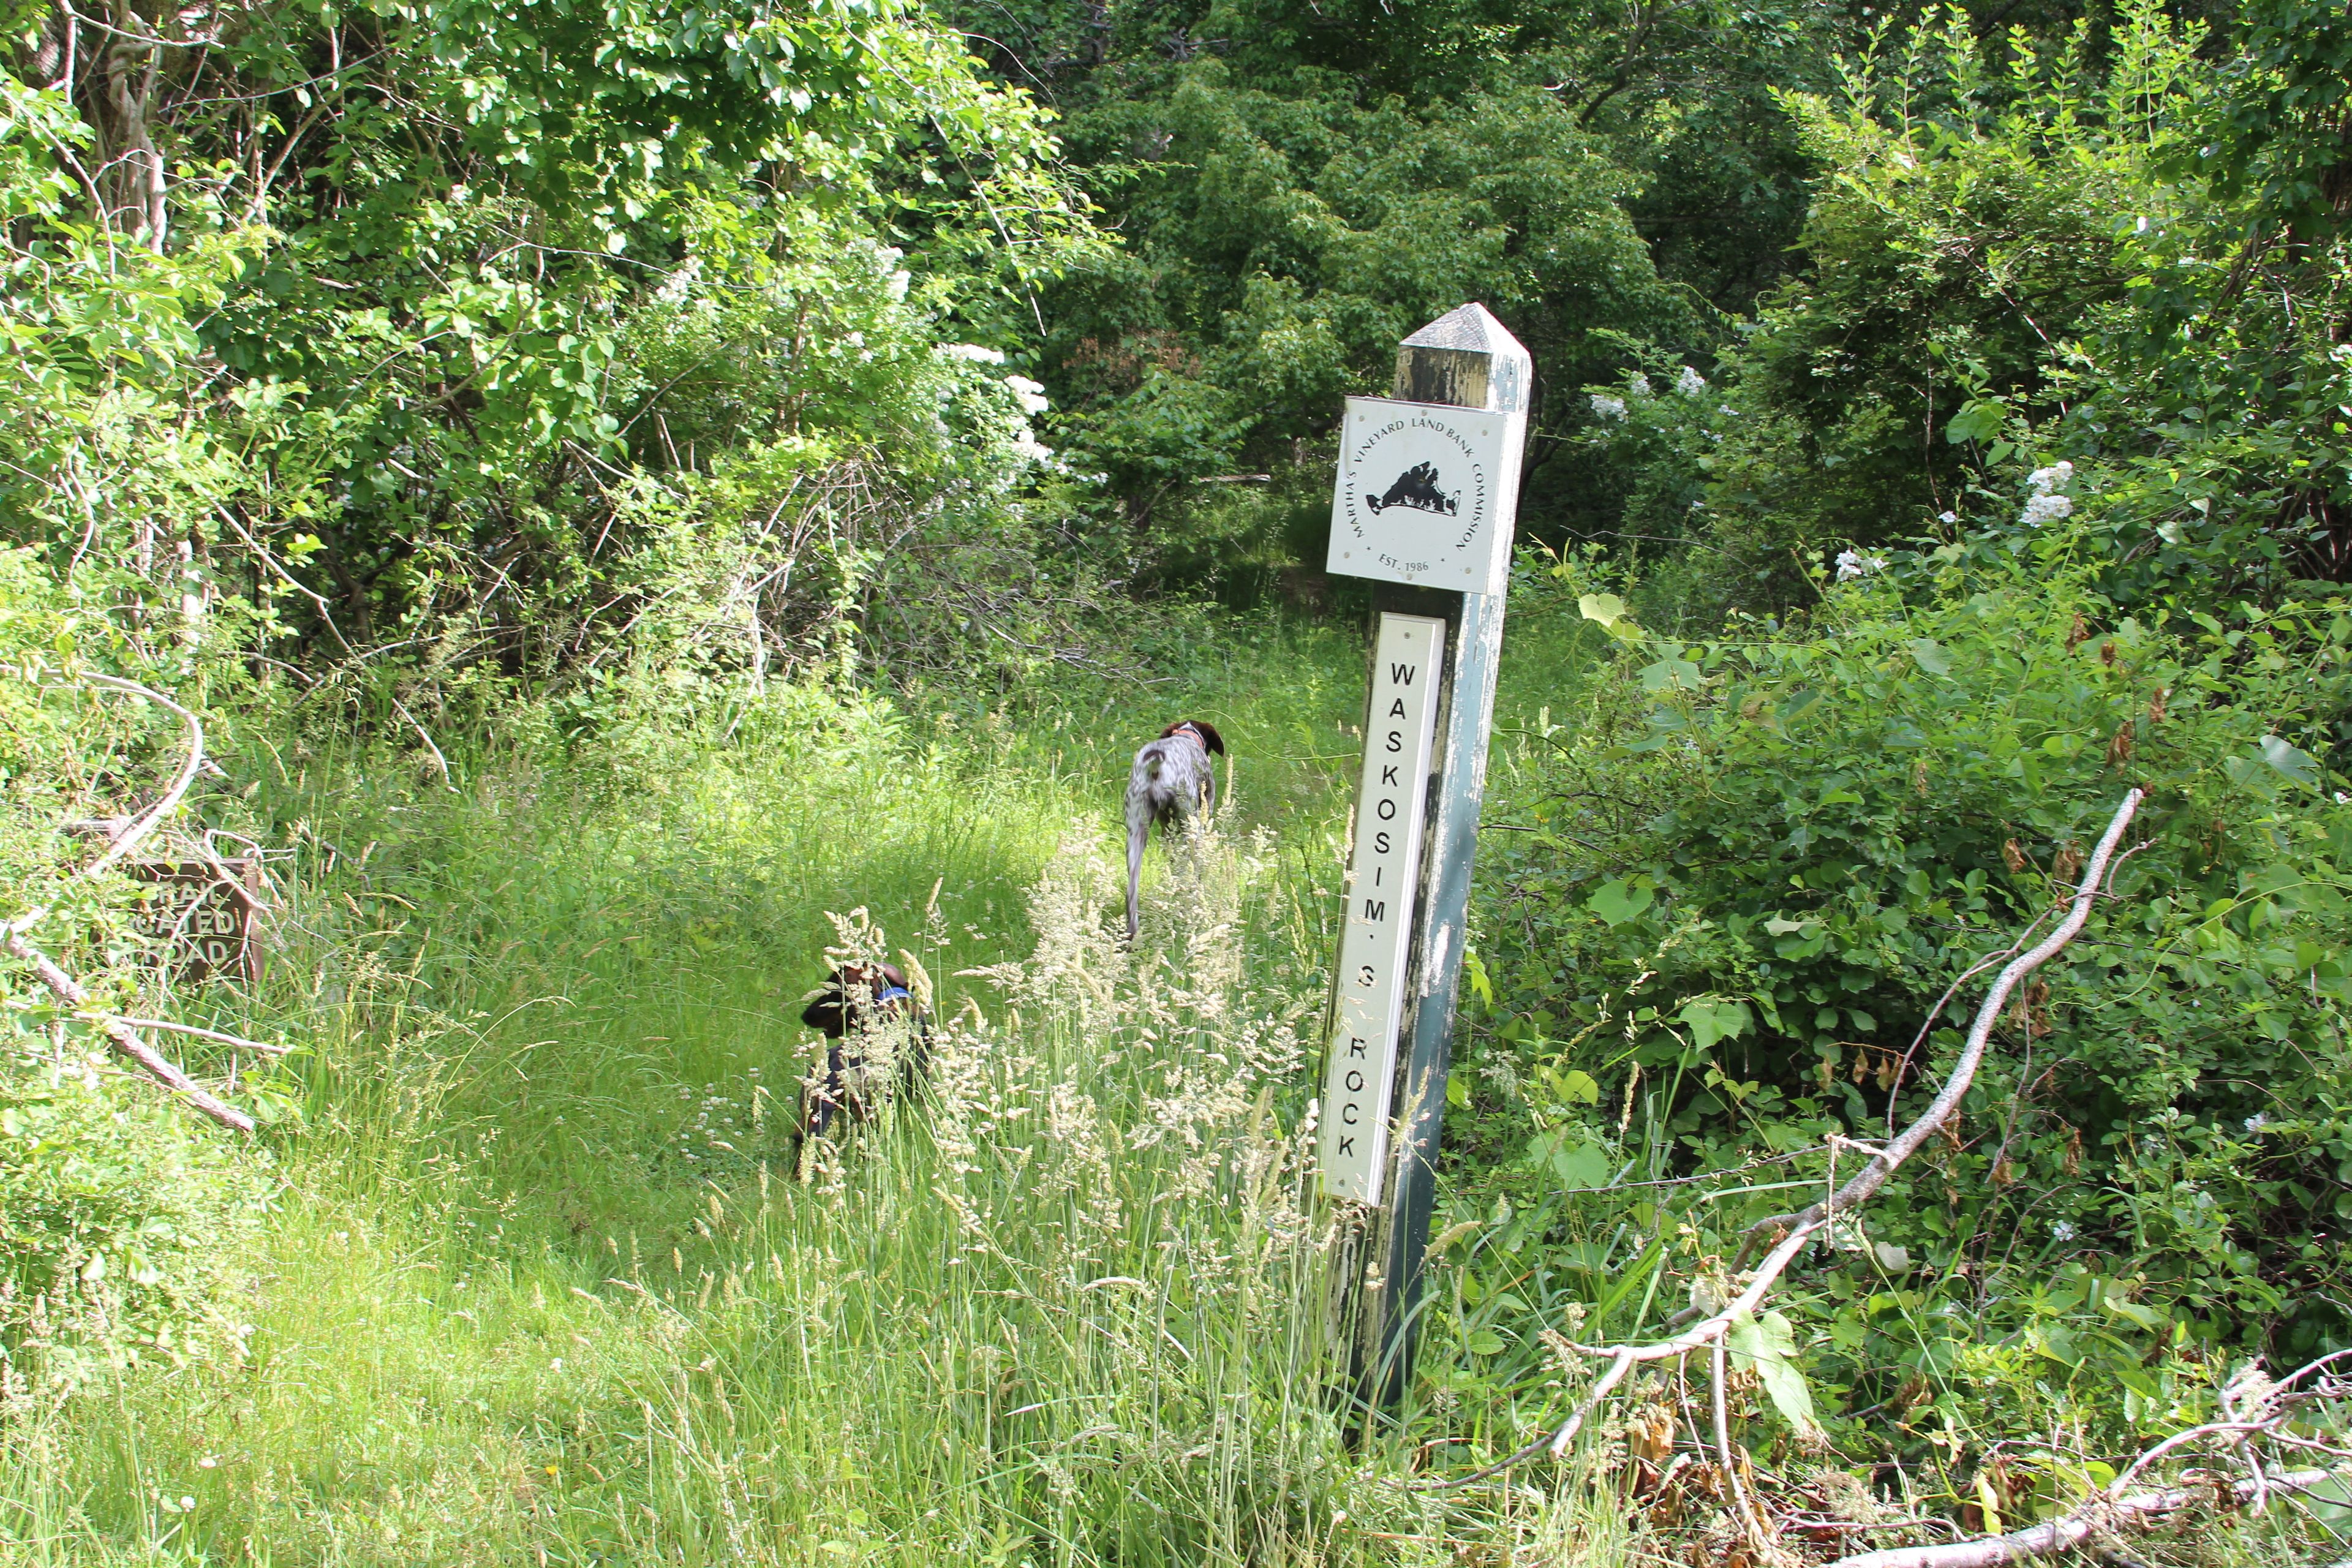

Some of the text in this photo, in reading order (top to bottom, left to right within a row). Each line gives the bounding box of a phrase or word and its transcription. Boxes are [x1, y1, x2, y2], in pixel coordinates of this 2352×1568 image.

[1344, 418, 1486, 552] MARTHA'S VINEYARD LAND BANK COMMISSION
[1378, 552, 1429, 572] EST. 1986
[1339, 1036, 1368, 1158] ROCK
